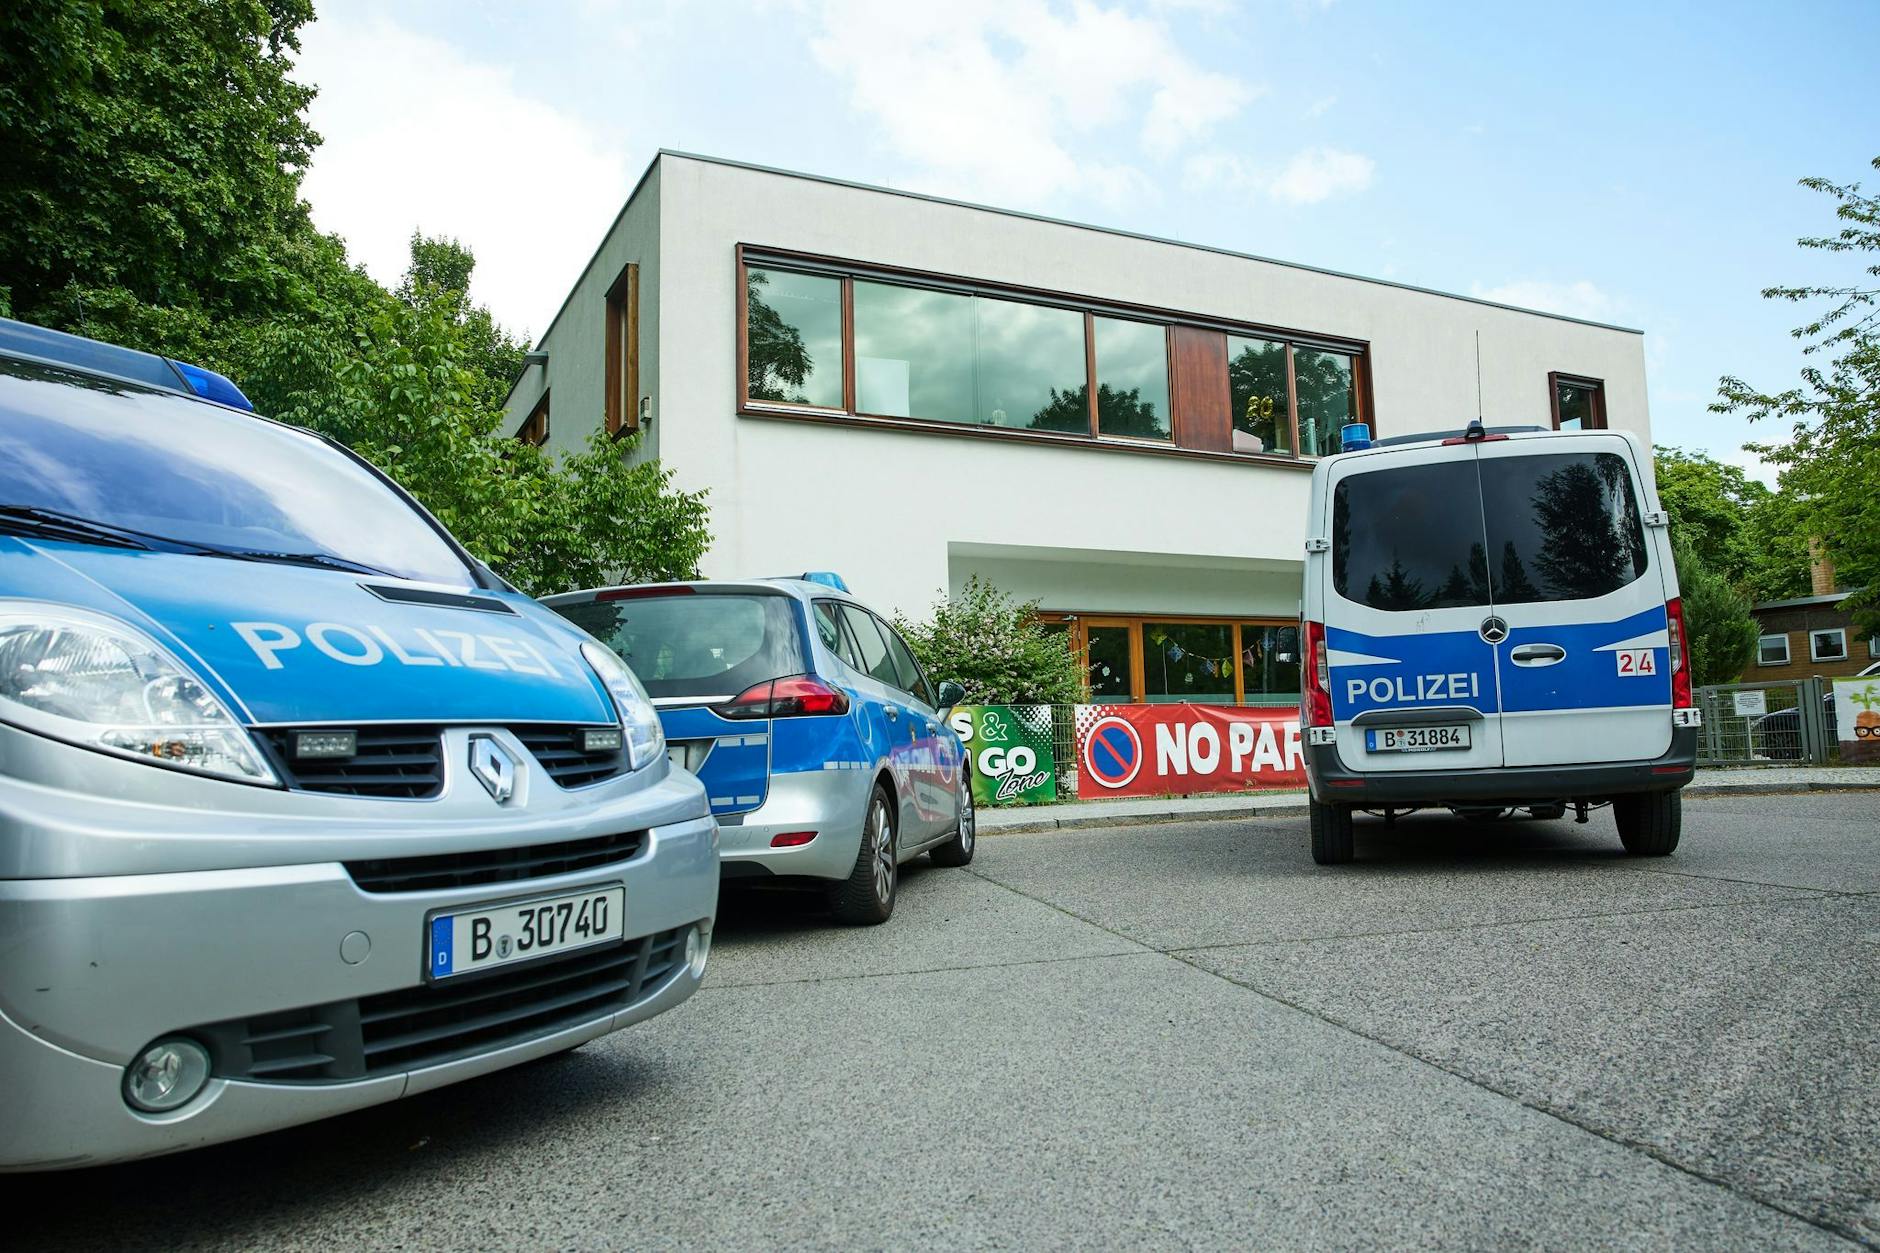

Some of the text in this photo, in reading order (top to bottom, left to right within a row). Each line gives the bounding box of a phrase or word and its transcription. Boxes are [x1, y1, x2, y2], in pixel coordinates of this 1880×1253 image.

[229, 622, 563, 679] POLIZEI
[1620, 652, 1653, 673] 24
[1347, 672, 1479, 704] POLIZEI
[979, 712, 1008, 741] &
[1384, 728, 1460, 747] B 31884
[978, 746, 1036, 777] GO
[1155, 721, 1221, 776] NO
[996, 768, 1050, 800] Zone
[472, 896, 607, 961] B 30740
[438, 952, 447, 965] D
